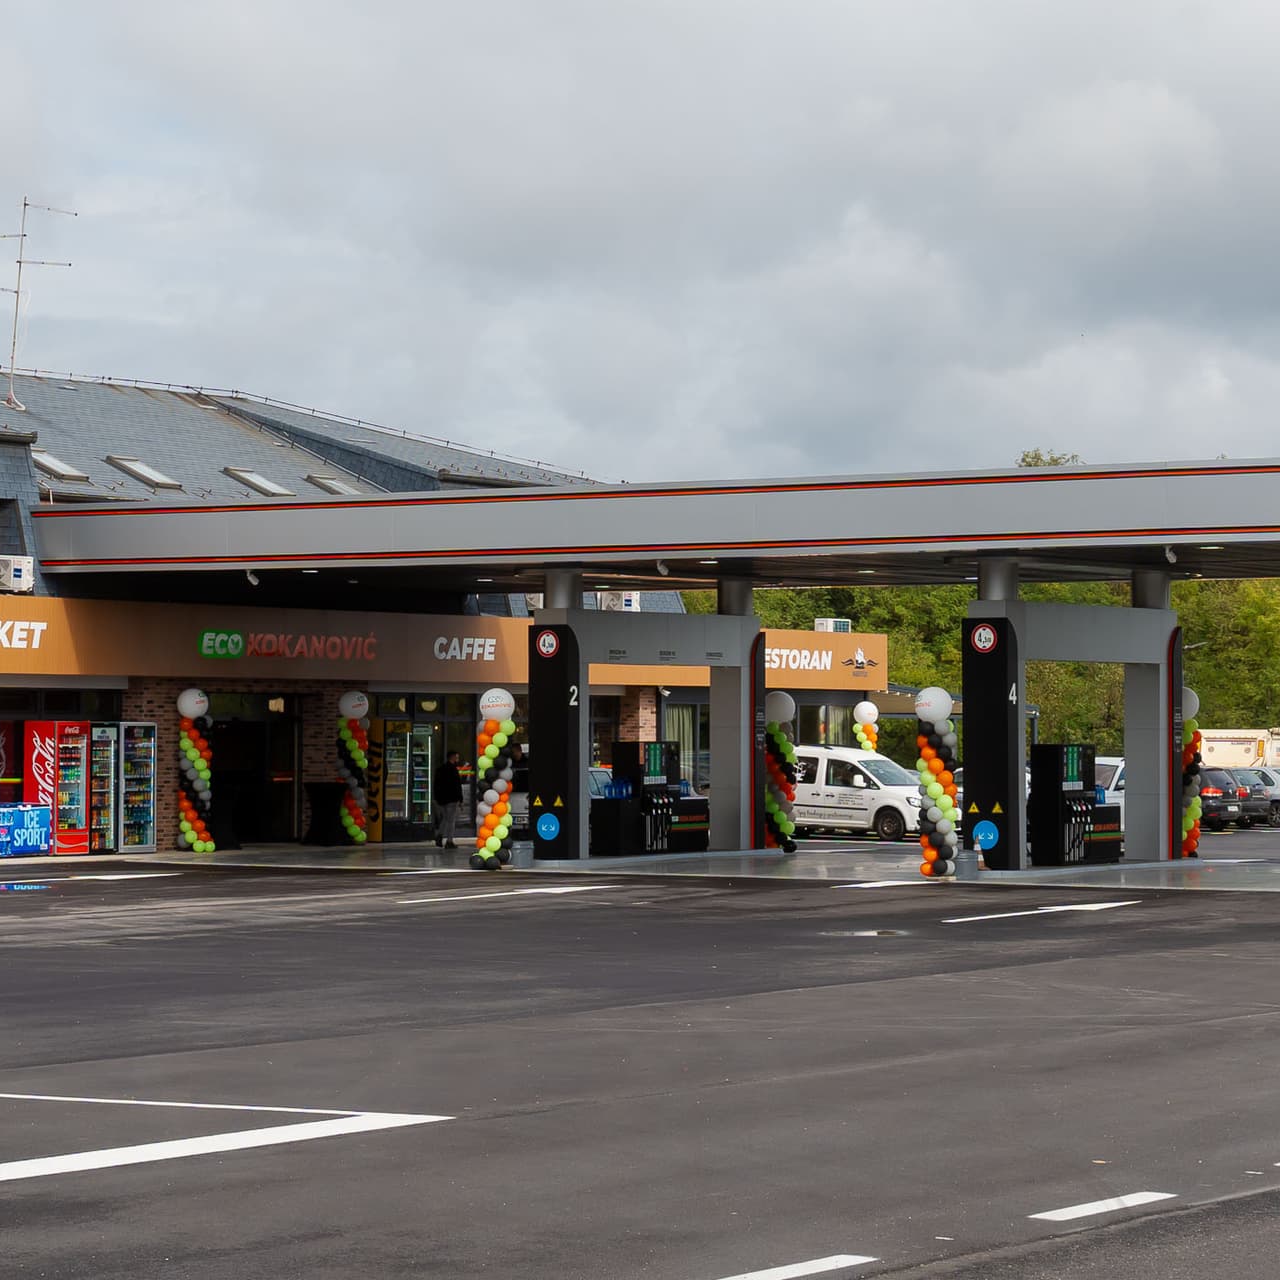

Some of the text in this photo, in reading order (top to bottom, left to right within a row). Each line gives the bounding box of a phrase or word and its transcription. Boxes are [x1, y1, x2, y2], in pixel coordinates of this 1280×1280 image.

[202, 631, 377, 661] ECO KOKANOVIĆ
[433, 636, 497, 661] CAFFE
[765, 648, 833, 670] ESTORAN
[569, 685, 578, 706] 2
[1008, 683, 1017, 705] 4
[24, 811, 40, 828] ICE
[14, 828, 47, 847] SPORT
